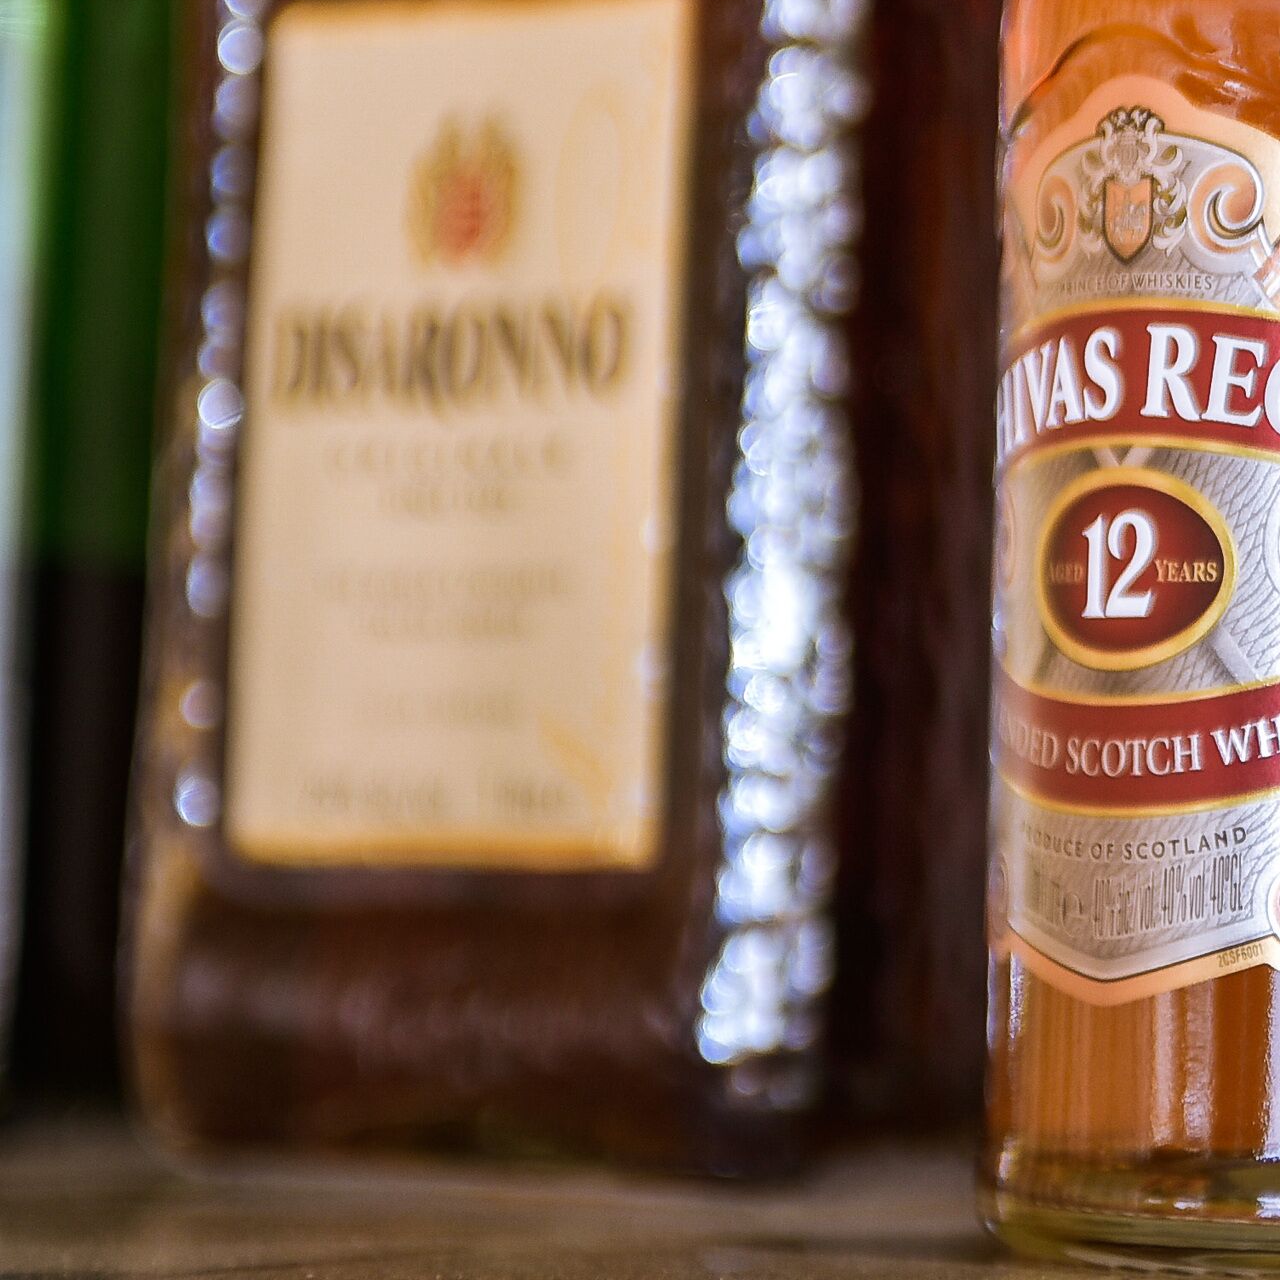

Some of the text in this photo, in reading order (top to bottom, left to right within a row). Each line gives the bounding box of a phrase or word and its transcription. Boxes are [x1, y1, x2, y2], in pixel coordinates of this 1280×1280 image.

[1131, 272, 1214, 291] WHISKIES
[1080, 508, 1158, 619] 12
[1154, 558, 1218, 583] YEARS
[1065, 731, 1203, 778] SCOTCH
[1090, 842, 1114, 860] OF
[1122, 825, 1249, 861] SCOTLAND
[1160, 864, 1187, 926] 40%
